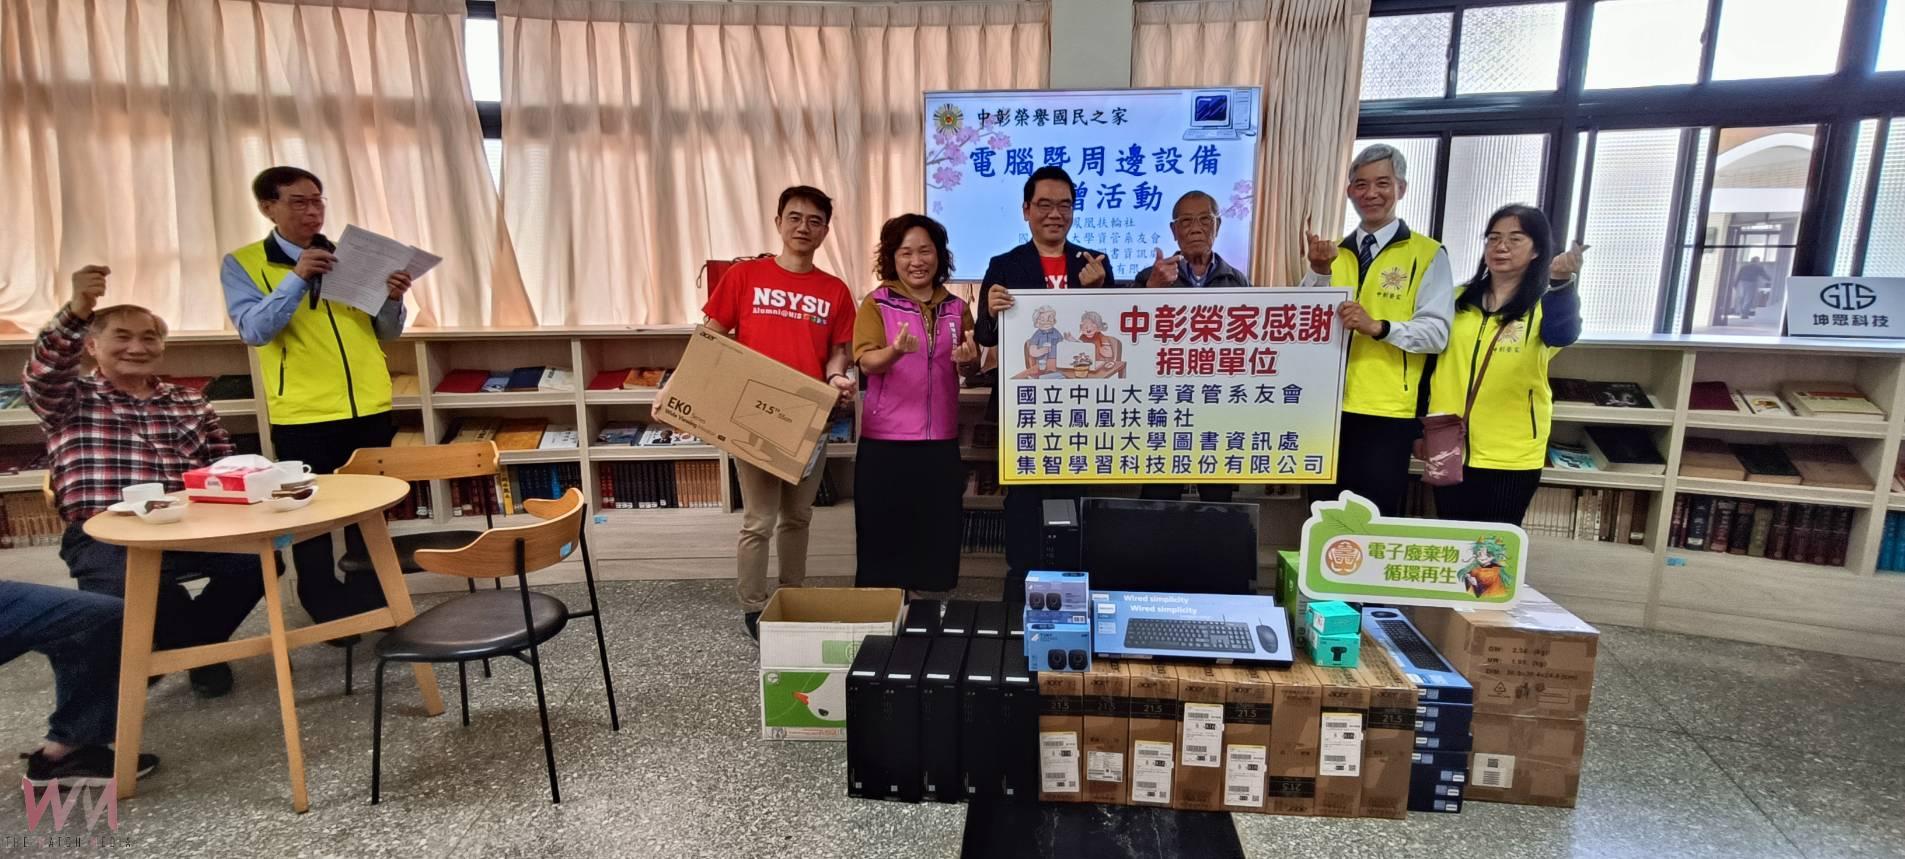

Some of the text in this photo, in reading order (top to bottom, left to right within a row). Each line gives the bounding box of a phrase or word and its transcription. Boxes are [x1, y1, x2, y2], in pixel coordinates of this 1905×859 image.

[976, 107, 1129, 126] 中彰榮譽國民之家
[969, 143, 1222, 178] 電腦暨周邊設備
[752, 286, 832, 318] NSYSU
[1819, 282, 1877, 310] GIS
[1119, 303, 1335, 343] 中彰榮家感謝
[1155, 347, 1279, 376] 捐贈單位
[1016, 384, 1304, 406] 國立中山大學資管系友會
[1016, 408, 1195, 429] 屏東鳳凰扶輪社
[1016, 431, 1300, 452] 國立中山大學圖書資訊處
[1016, 454, 1324, 476] 集智學習科技股份有限公司
[1367, 541, 1460, 563] 電子廢棄物
[1383, 563, 1458, 585] 循環再生
[1123, 594, 1190, 604] Wired simplicity
[1130, 604, 1198, 615] Wired simplicity
